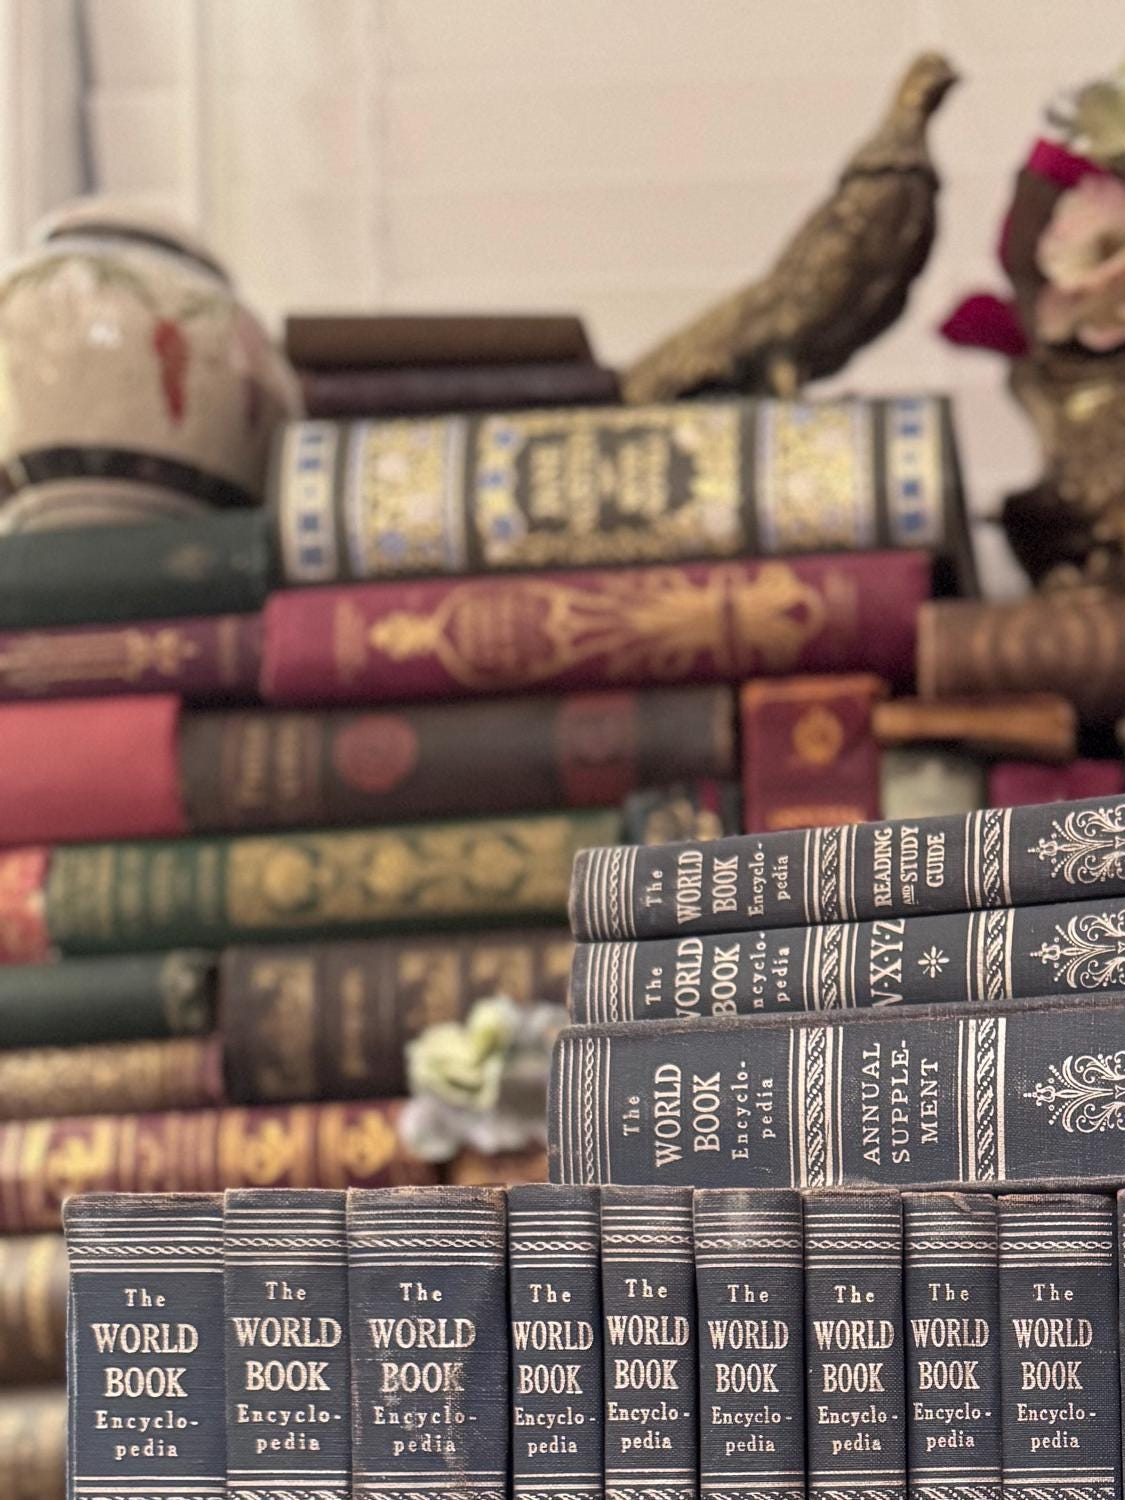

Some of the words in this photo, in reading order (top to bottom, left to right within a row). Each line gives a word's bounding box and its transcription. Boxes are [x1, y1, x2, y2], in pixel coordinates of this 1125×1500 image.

[874, 828, 892, 905] READING
[900, 826, 919, 882] STUDY
[927, 833, 944, 887] GUIDE
[646, 871, 662, 907] The
[676, 851, 702, 922] WORLD
[712, 856, 738, 913] BOOK
[748, 843, 766, 915] Encyclo-
[772, 856, 790, 899] pedia
[646, 968, 662, 1005] The
[711, 943, 740, 1016] BOOK
[772, 948, 789, 1001] pedia
[654, 1064, 682, 1167] WORLD
[693, 1072, 720, 1151] BOOK
[731, 1061, 751, 1159] Encyclo-
[756, 1079, 775, 1138] pedia
[862, 1043, 880, 1165] ANNUAL
[892, 1040, 910, 1163] SUPPLE-
[921, 1058, 938, 1143] MENT
[623, 1096, 640, 1136] The
[125, 1289, 165, 1306] The
[400, 1283, 442, 1301] The
[625, 1279, 667, 1298] The
[834, 1285, 874, 1303] The
[1034, 1284, 1073, 1301] The
[232, 1318, 341, 1347] WORLD
[369, 1319, 475, 1348] WORLD
[513, 1321, 593, 1350] WORLD
[708, 1320, 788, 1349] WORLD
[911, 1318, 989, 1347] WORLD
[105, 1367, 187, 1397] BOOK
[615, 1359, 678, 1389] BOOK
[823, 1363, 884, 1392] BOOK
[1021, 1361, 1083, 1390] BOOK
[237, 1404, 341, 1426] Encyclo-
[515, 1407, 595, 1428] Encyclo-
[712, 1406, 792, 1427] Encyclo-
[913, 1403, 991, 1423] Encyclo-
[115, 1438, 178, 1460] pedia
[621, 1431, 672, 1453] pedia
[832, 1433, 881, 1455] pedia
[1031, 1431, 1080, 1452] pedia
